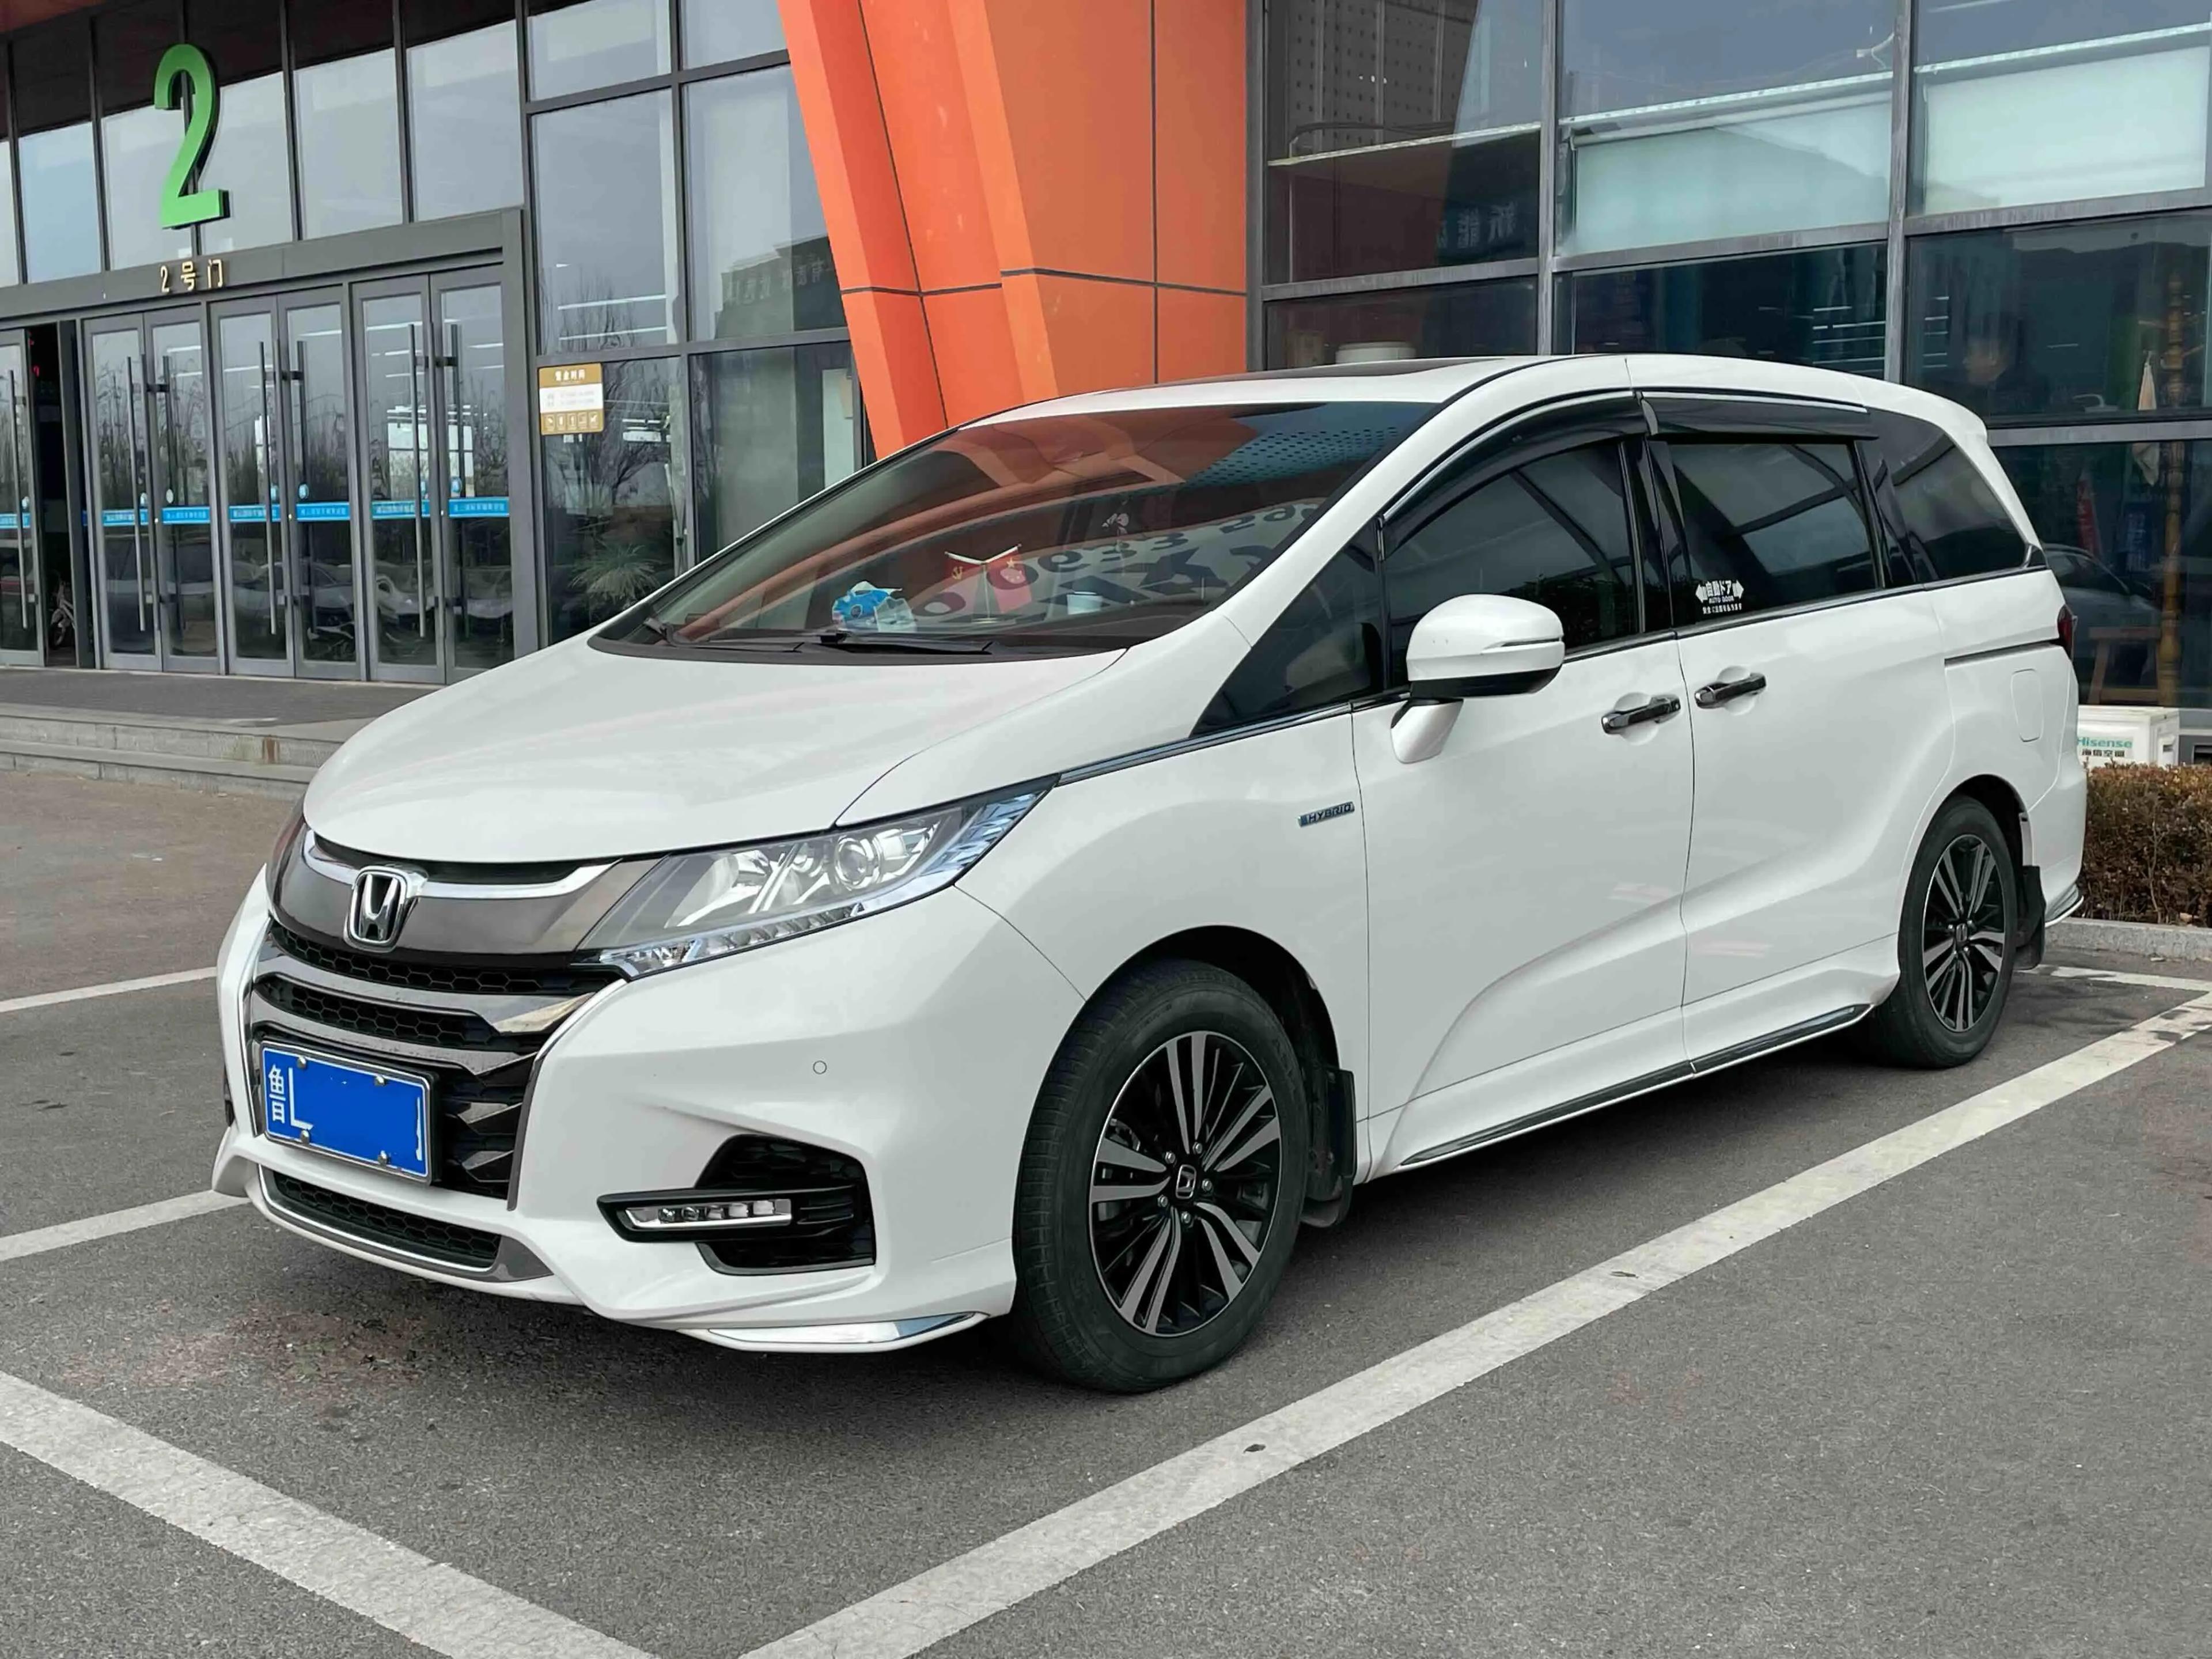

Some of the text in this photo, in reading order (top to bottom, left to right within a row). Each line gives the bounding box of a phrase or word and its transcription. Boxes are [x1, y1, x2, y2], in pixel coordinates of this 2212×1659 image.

[154, 43, 226, 229] 2
[160, 259, 224, 293] 2号门
[2077, 737, 2133, 748] Hisense
[1308, 803, 1352, 823] HYBRID
